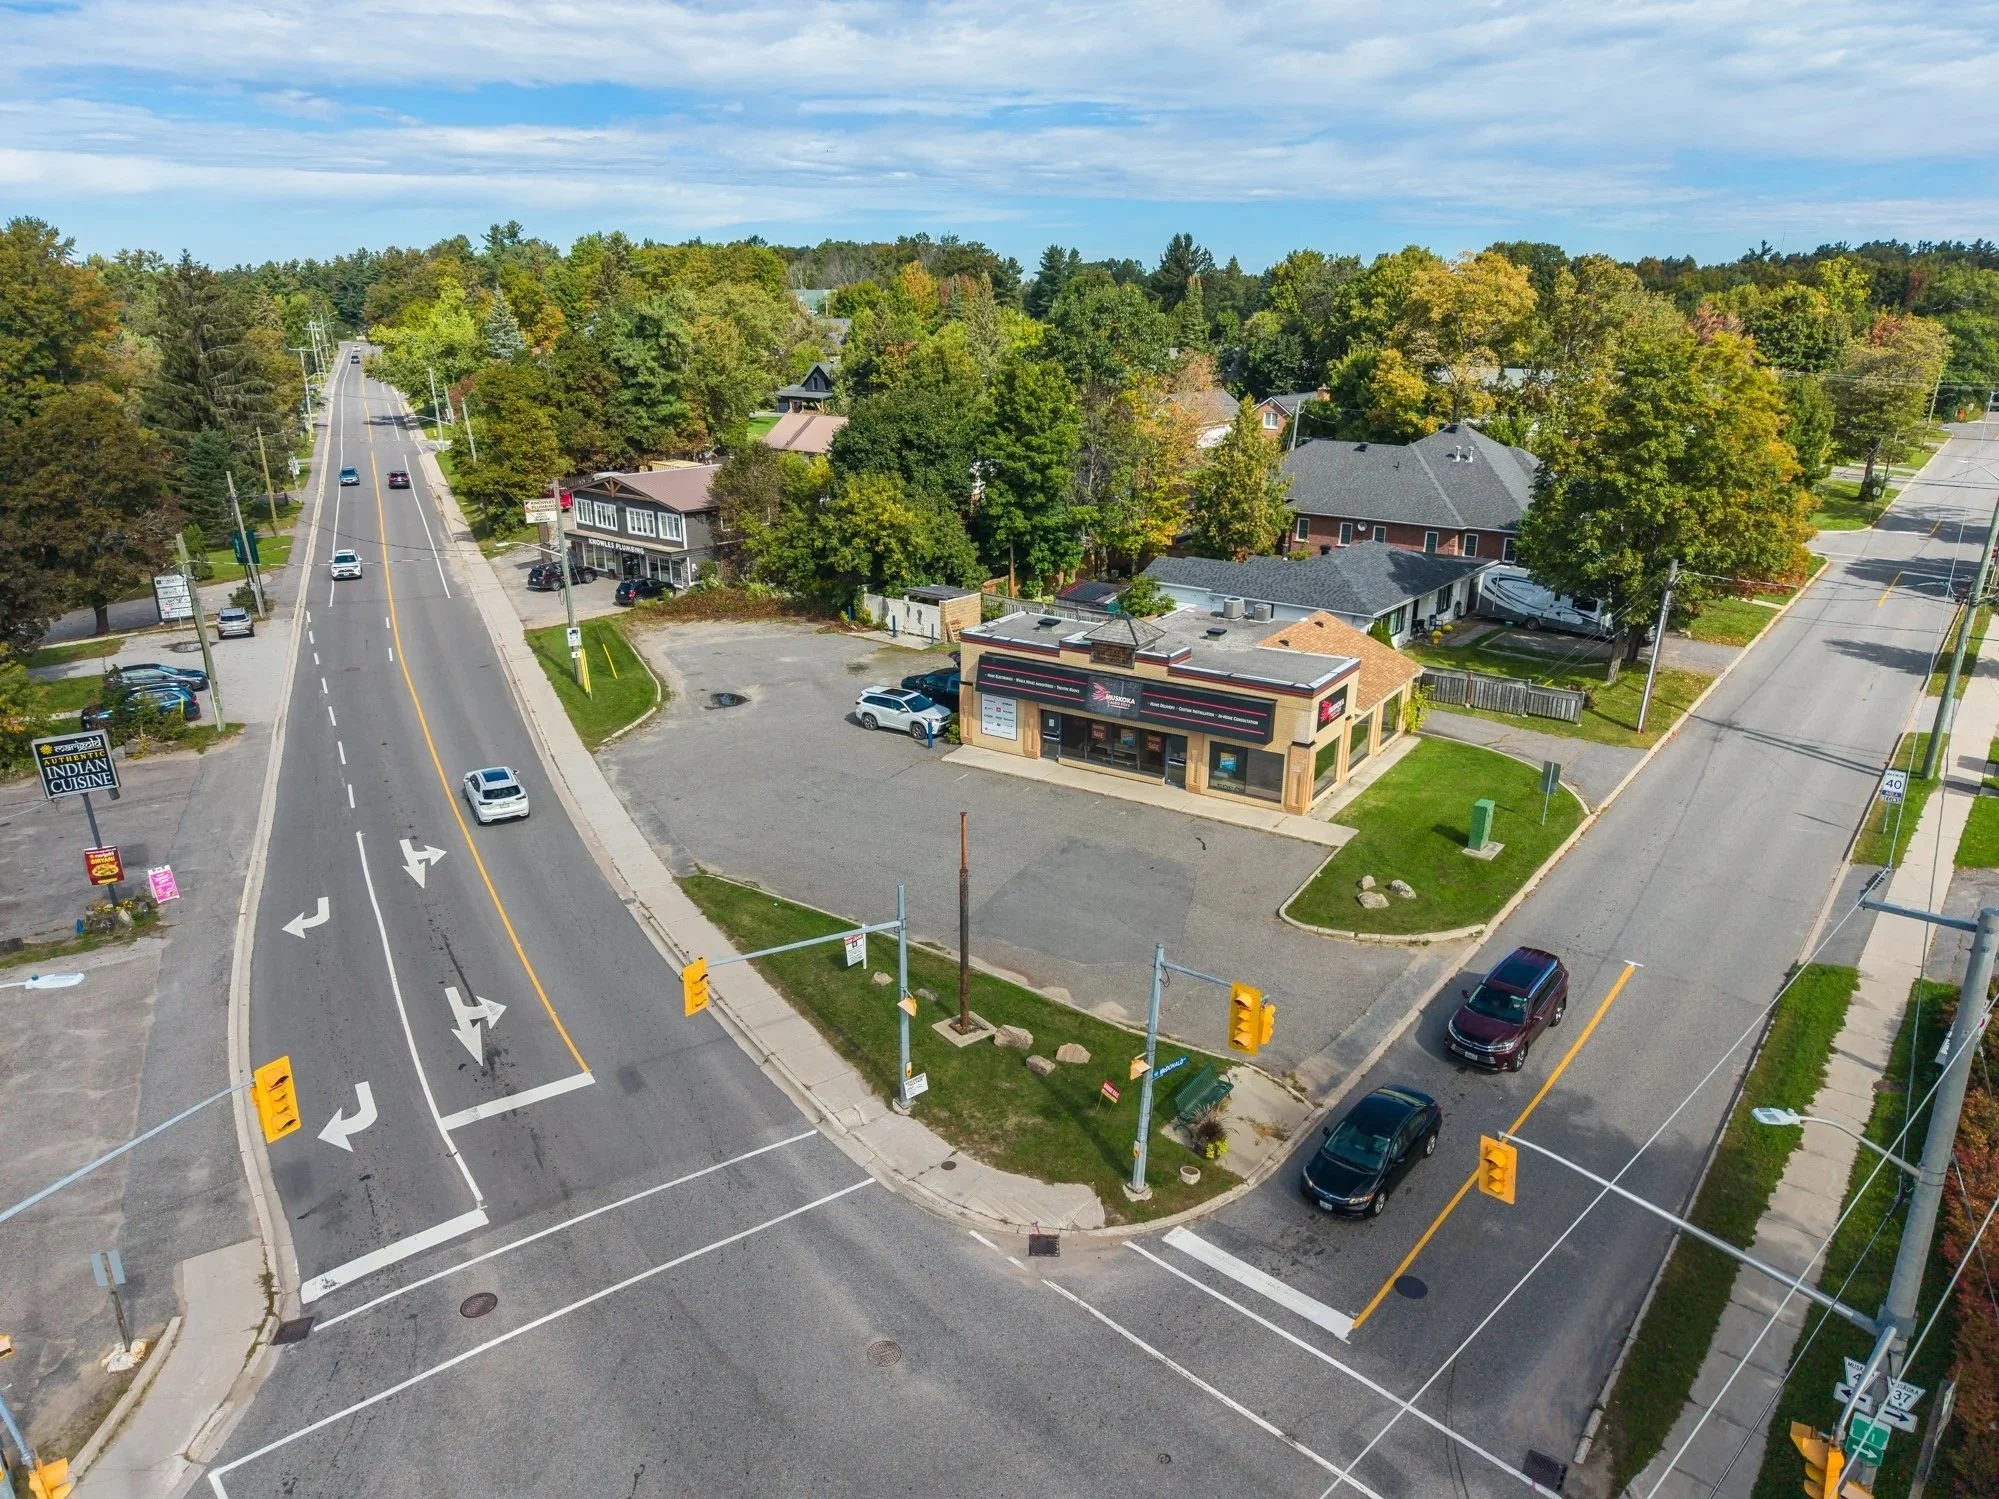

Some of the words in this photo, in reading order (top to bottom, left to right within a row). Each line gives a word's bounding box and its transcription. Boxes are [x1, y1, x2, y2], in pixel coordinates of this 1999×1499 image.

[588, 538, 614, 549] KNOWLES
[615, 543, 644, 555] PLUMBING
[1105, 693, 1136, 705] MUSKOKA
[53, 736, 102, 753] marigold
[44, 750, 106, 766] AUTHENTIC
[45, 758, 109, 780] INDIAN
[50, 771, 113, 793] CUISINE
[1885, 779, 1902, 790] 40
[90, 856, 116, 865] BIRYANI
[1893, 1389, 1912, 1403] 37
